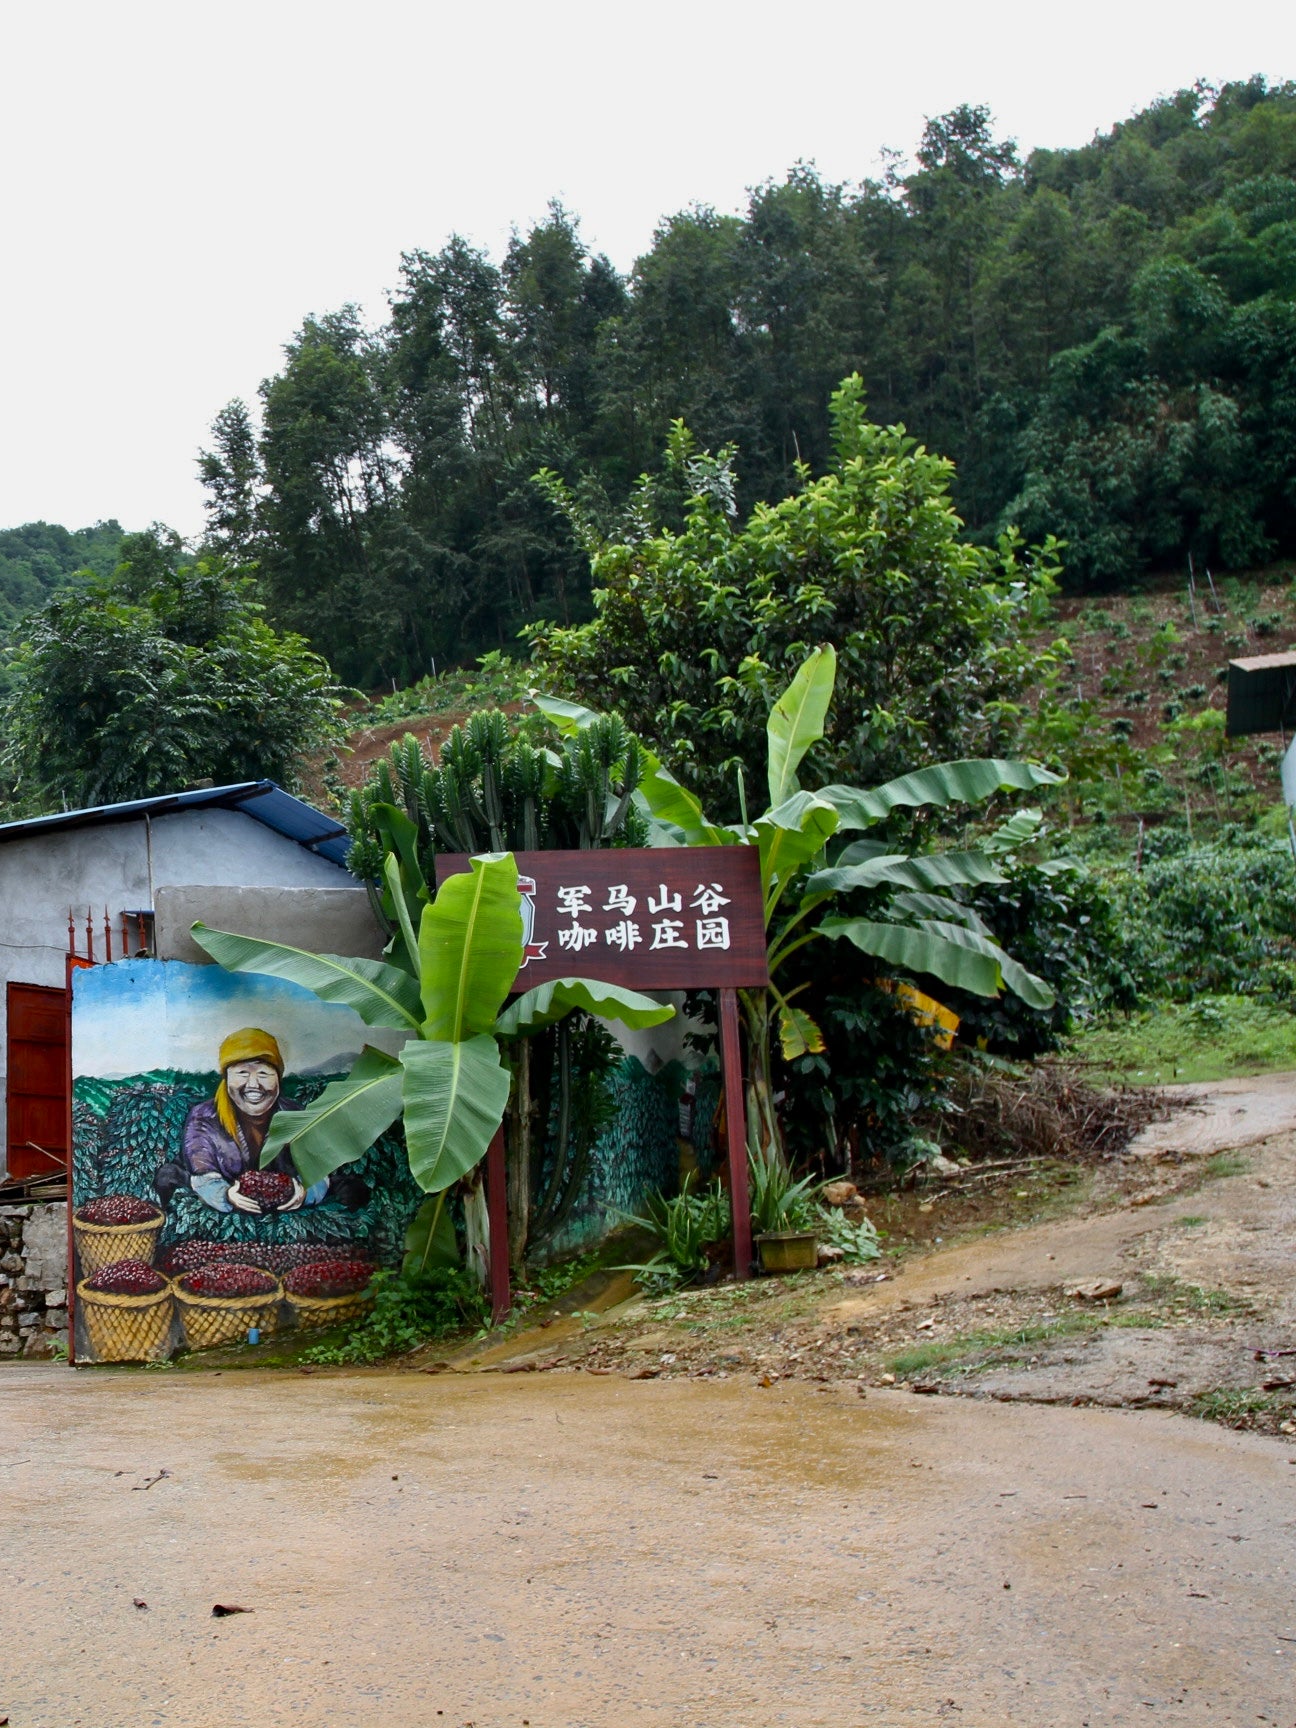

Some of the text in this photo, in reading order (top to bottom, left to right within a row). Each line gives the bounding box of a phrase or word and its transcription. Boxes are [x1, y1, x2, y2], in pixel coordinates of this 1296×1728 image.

[556, 883, 732, 918] 军马山谷
[557, 916, 731, 952] 咖啡庄园
